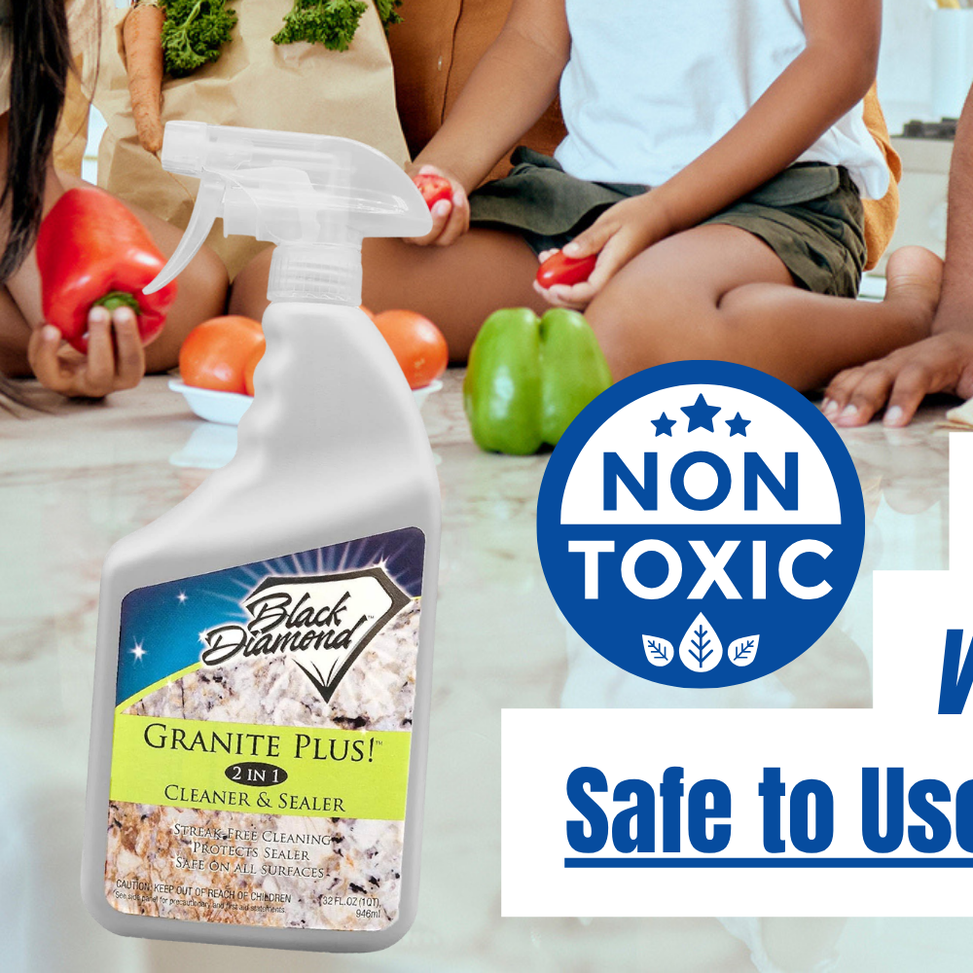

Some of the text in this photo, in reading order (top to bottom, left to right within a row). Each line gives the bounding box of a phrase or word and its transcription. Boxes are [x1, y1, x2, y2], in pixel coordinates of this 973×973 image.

[246, 591, 351, 631] Black
[201, 615, 367, 667] Diamond
[143, 723, 280, 758] GRANITE
[294, 733, 375, 763] PLUS!
[232, 766, 280, 783] 2 IN 1
[164, 784, 346, 812] CLEANER & SEALER
[174, 823, 331, 846] STREAK-FREE CLEANING
[193, 841, 310, 860] PROTECTS SEALER
[175, 857, 324, 878] SAFE ON ALL SURFACES
[154, 883, 174, 894] KEEP
[176, 886, 192, 896] OUT
[195, 887, 206, 897] OF
[208, 888, 235, 899] REACH
[237, 890, 248, 900] OF
[251, 891, 292, 903] CHILDREN
[323, 897, 333, 906] 32
[356, 909, 380, 919] 946ml
